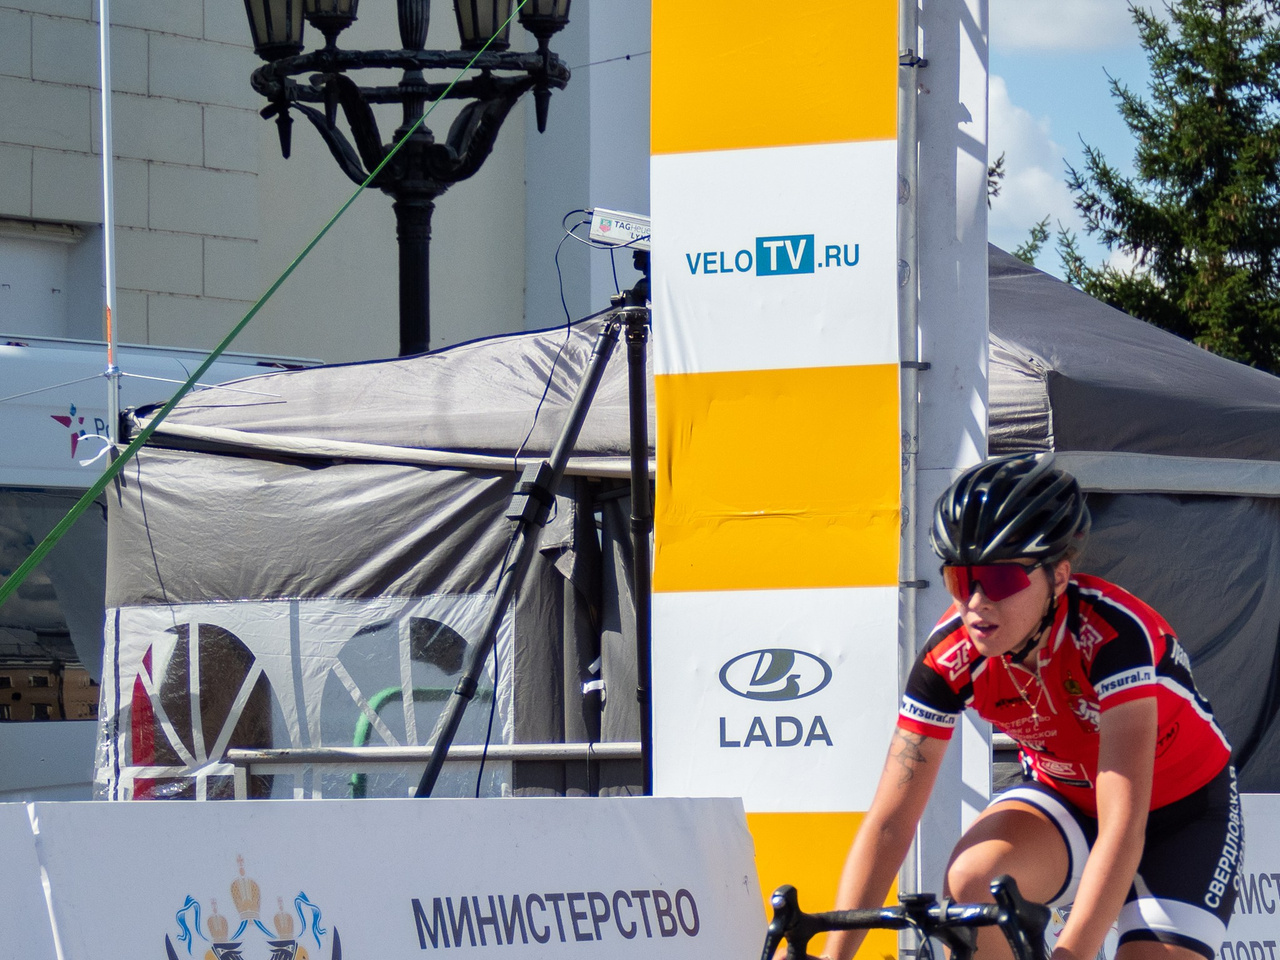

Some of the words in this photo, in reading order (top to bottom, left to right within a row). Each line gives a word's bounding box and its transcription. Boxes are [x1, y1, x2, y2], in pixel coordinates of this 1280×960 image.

[719, 715, 834, 748] LADA
[1204, 765, 1240, 909] СВЕРДЛОВСКАЯ
[411, 888, 700, 950] МИНИСТЕРСТВО
